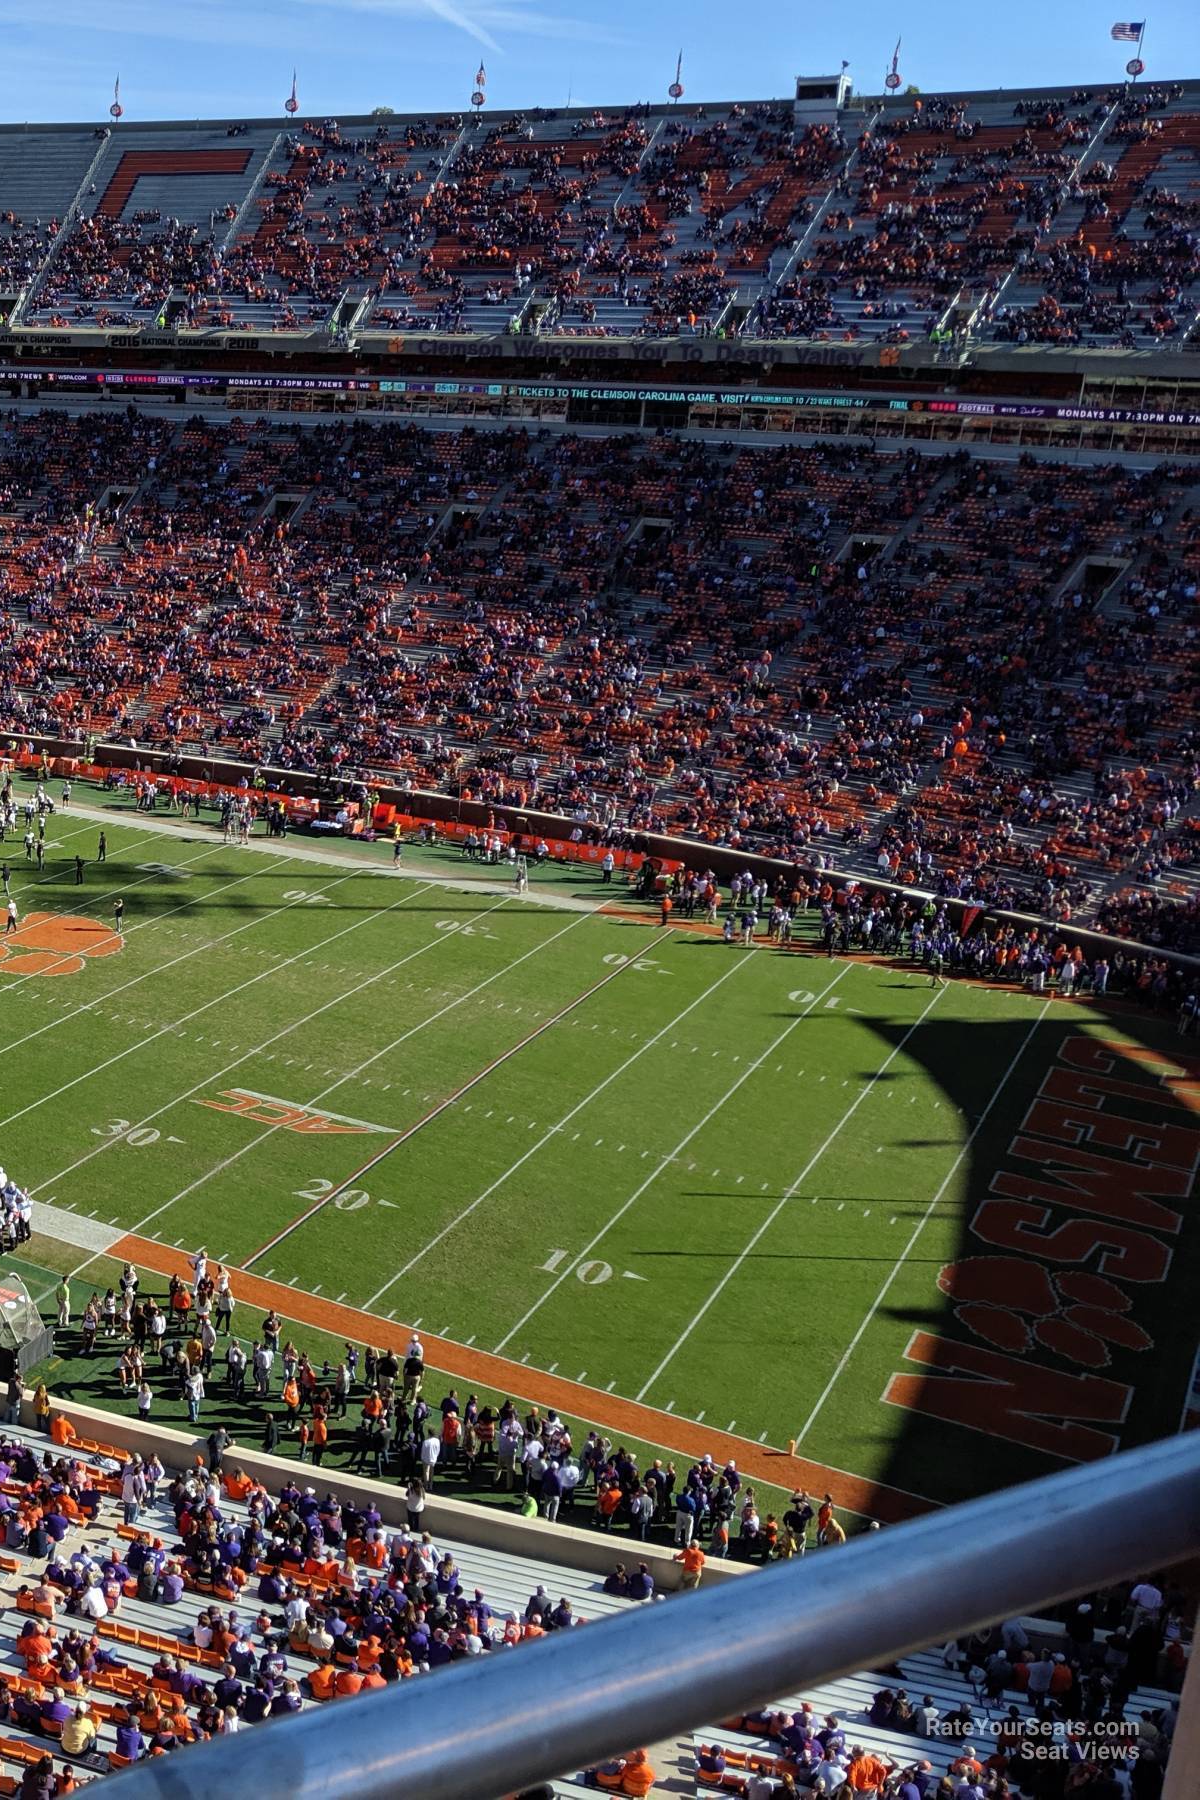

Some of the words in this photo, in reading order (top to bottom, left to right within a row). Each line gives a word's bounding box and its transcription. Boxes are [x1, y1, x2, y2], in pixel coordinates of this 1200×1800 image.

[30, 335, 72, 344] CHAMPIONS
[142, 337, 176, 346] NATIONAL
[178, 338, 221, 346] CHAMPIONS
[417, 340, 503, 356] Clemson
[513, 341, 619, 359] Welcomes
[632, 343, 668, 359] You
[678, 343, 703, 360] To
[716, 345, 783, 361] Death
[796, 347, 864, 366] Valley
[20, 372, 42, 380] 7NEWS
[158, 376, 184, 384] FOOTBALL
[275, 379, 302, 387] 7:30PM
[318, 380, 342, 388] 7NEWS
[518, 387, 555, 397] TICKETS
[557, 388, 569, 397] TO
[571, 389, 588, 398] THE
[590, 389, 636, 400] CLEMSON
[638, 391, 685, 401] CAROLINA
[687, 393, 717, 403] GAME.
[721, 393, 744, 403] VISIT
[890, 401, 908, 410] FINAL
[958, 403, 995, 413] FOOTBALL
[1056, 409, 1104, 419] MONDAYS
[1108, 410, 1120, 420] AT
[1125, 411, 1164, 421] 7:30PM
[1169, 414, 1183, 423] ON
[602, 953, 662, 971] 20
[788, 990, 842, 1008] 10
[90, 1118, 160, 1145] 30
[292, 1179, 369, 1210] 20
[533, 1248, 613, 1284] 10
